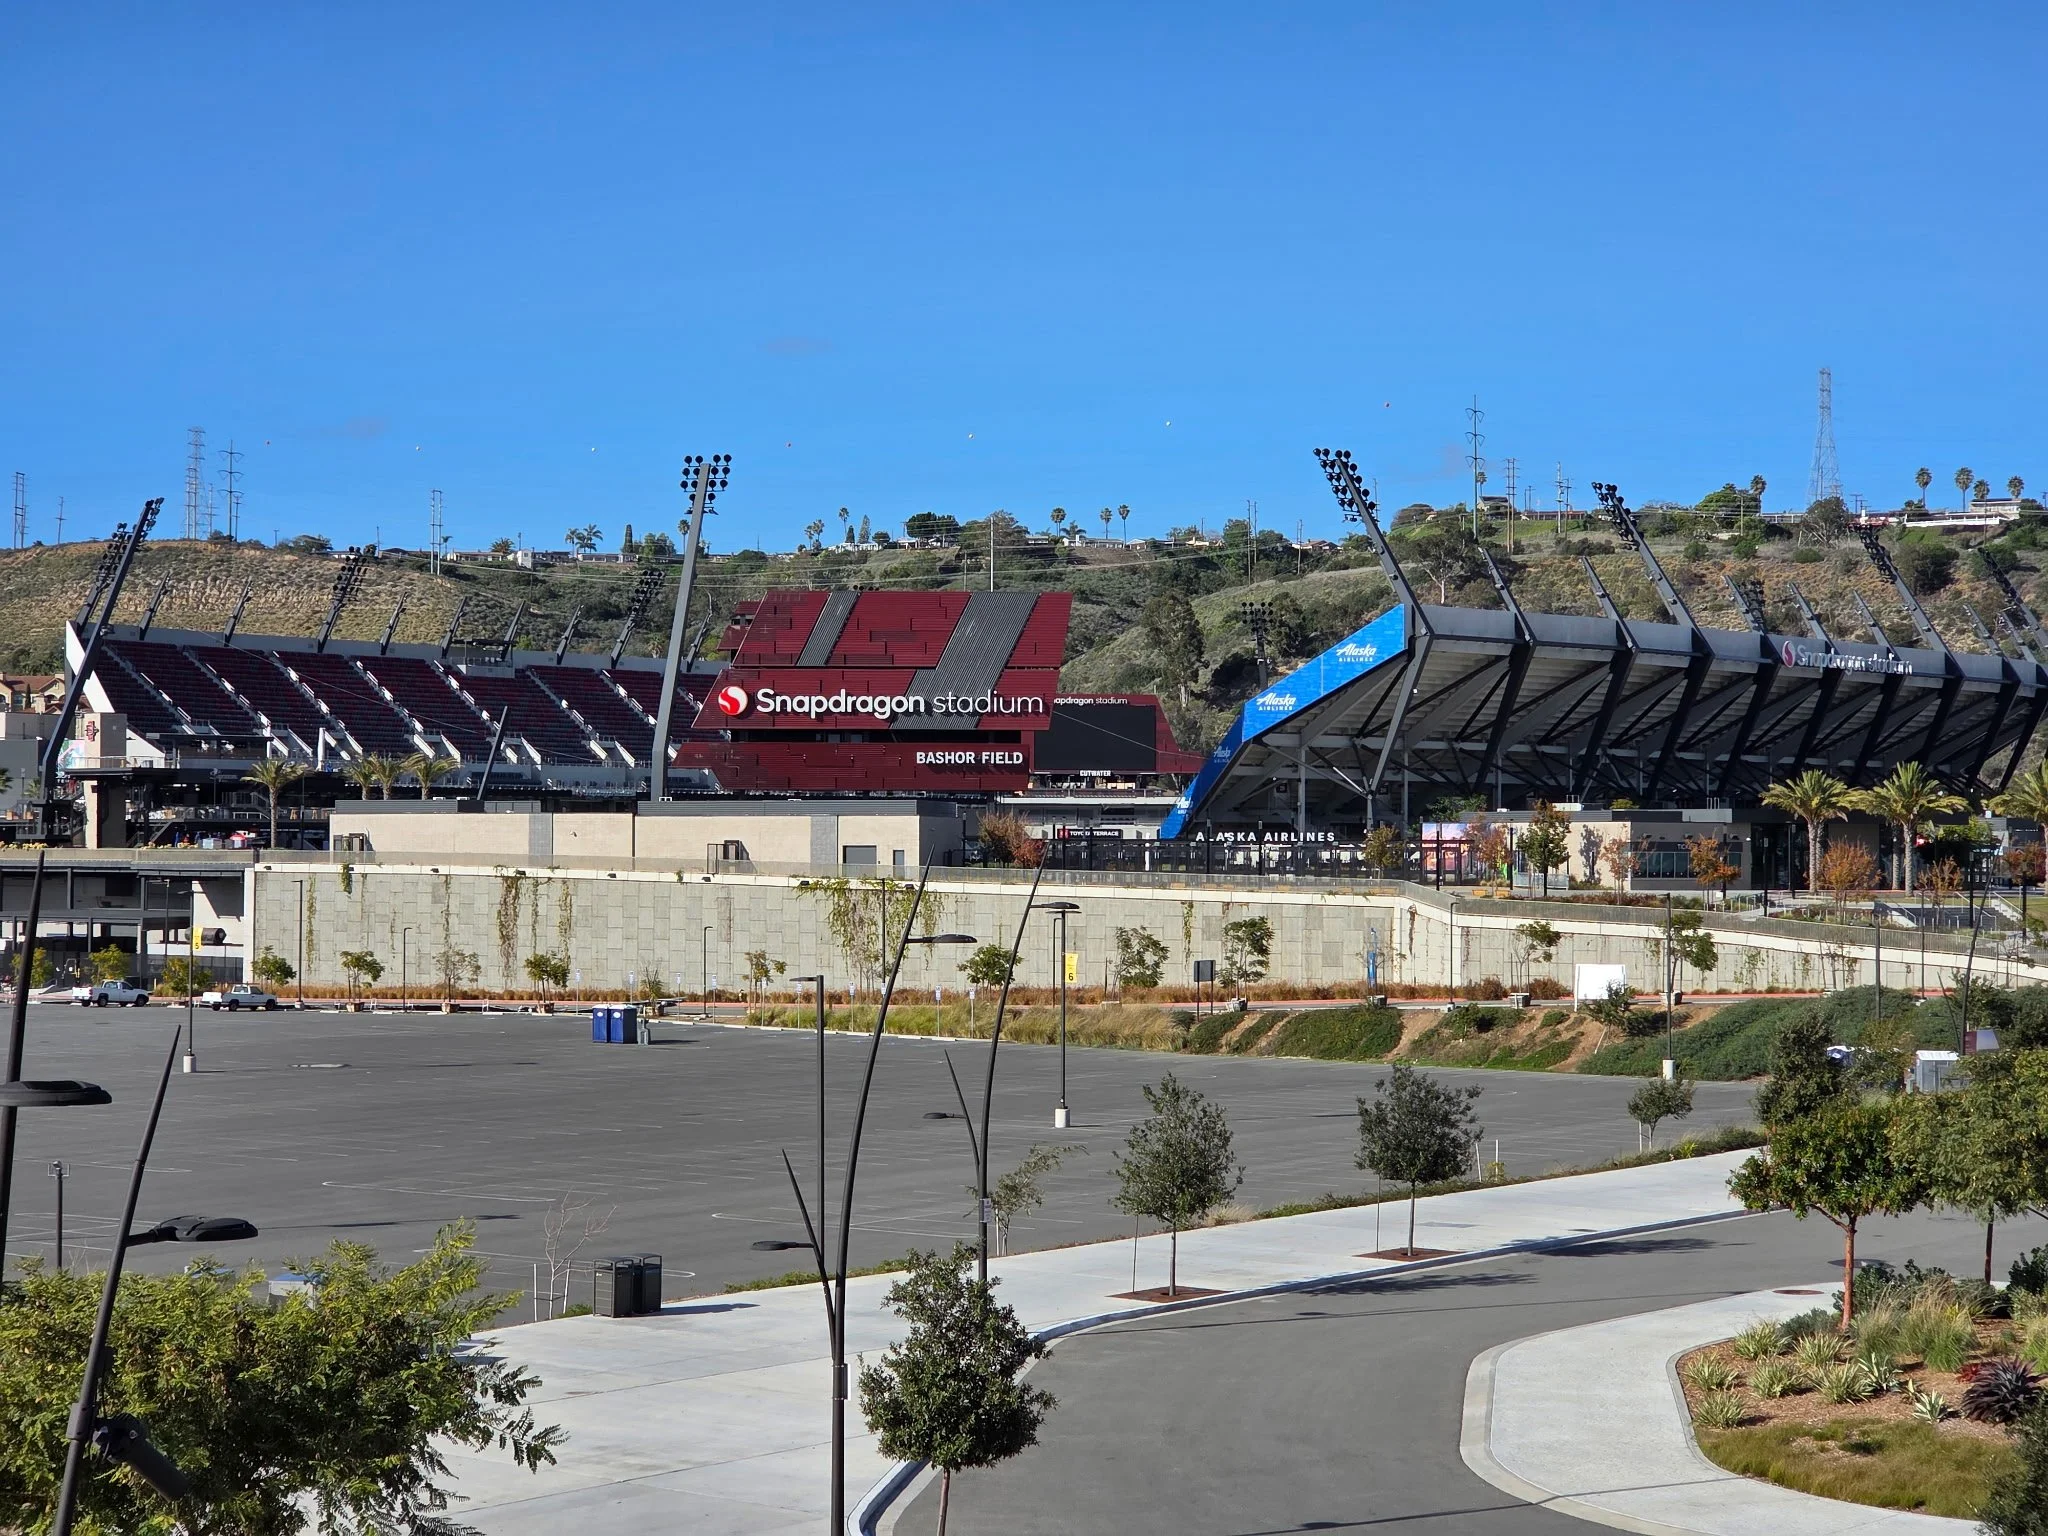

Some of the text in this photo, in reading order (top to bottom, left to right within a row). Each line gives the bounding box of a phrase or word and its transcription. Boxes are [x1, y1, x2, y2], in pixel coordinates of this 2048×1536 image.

[1336, 643, 1377, 657] Alaska
[756, 688, 1044, 720] Snapdragon stadium
[1053, 696, 1128, 706] apdragon stadium
[1256, 692, 1297, 706] Alaska
[916, 751, 1023, 764] BASHOR FIELD
[1195, 832, 1335, 841] AASKA AIRLINES
[1068, 972, 1074, 981] 6
